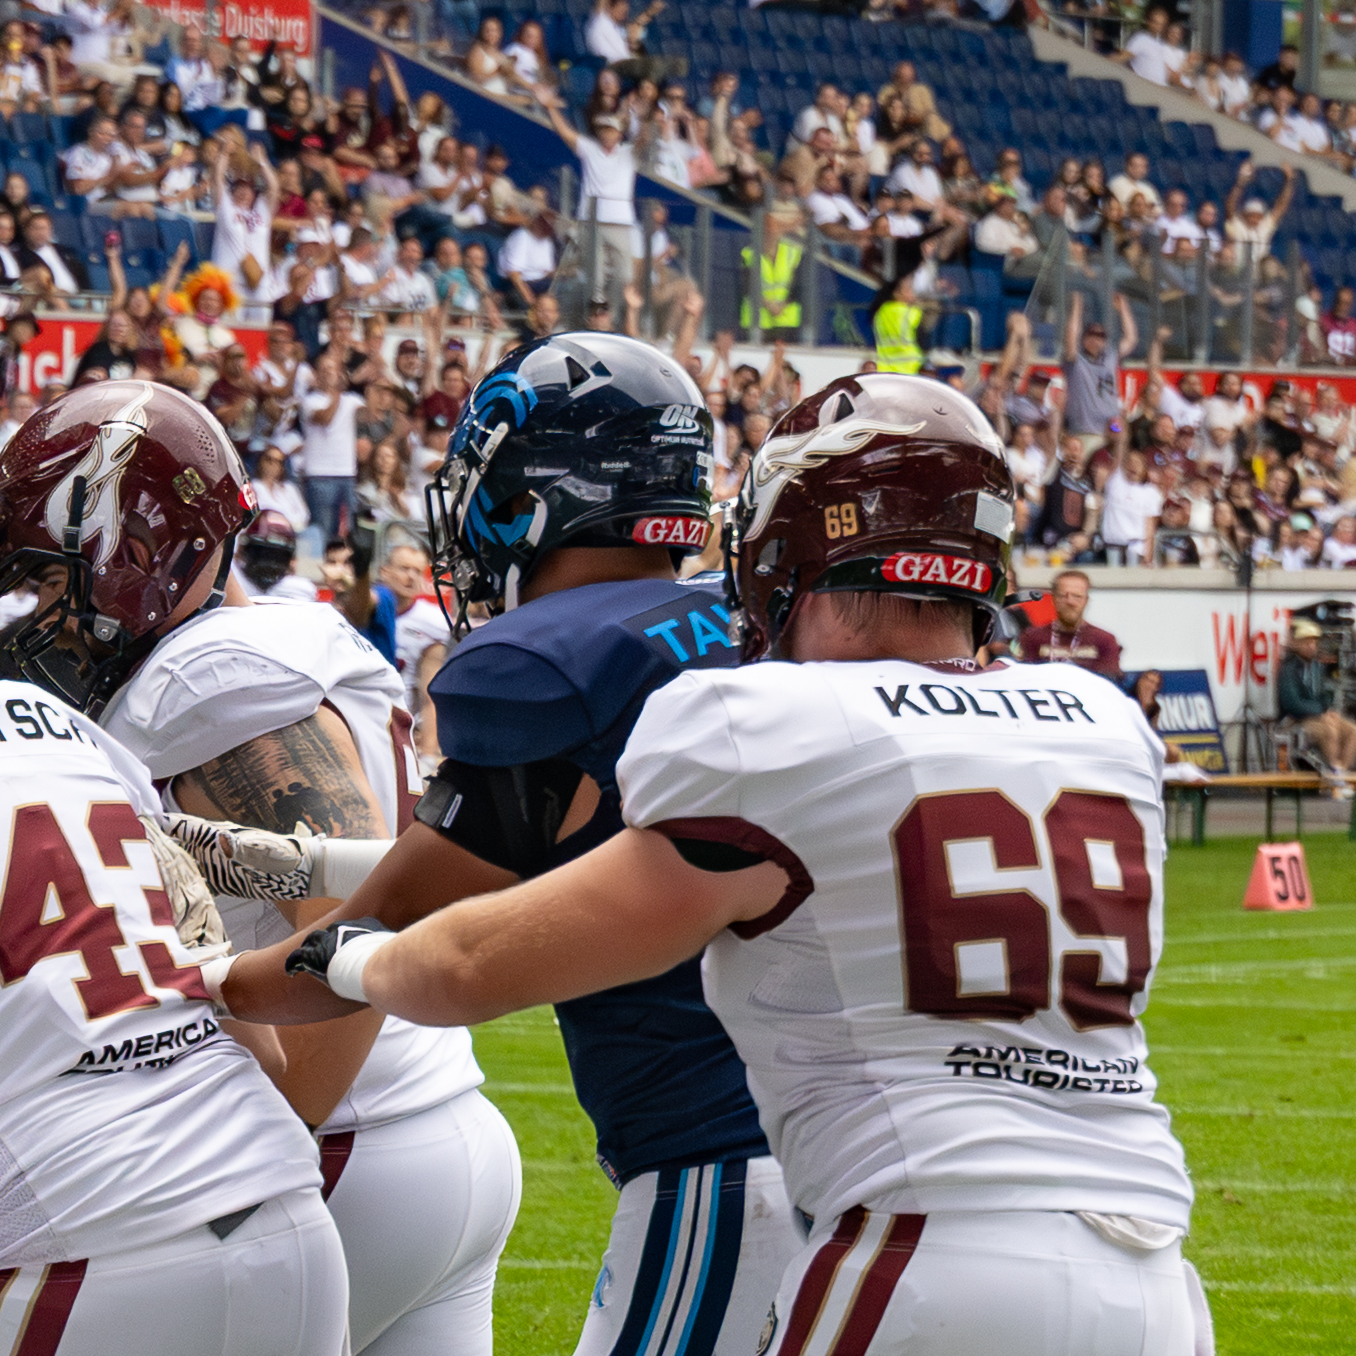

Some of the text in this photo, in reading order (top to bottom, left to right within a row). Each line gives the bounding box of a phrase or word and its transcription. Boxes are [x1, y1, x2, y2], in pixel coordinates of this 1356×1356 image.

[824, 502, 858, 539] 69
[873, 684, 1096, 724] KOLTER
[1270, 856, 1306, 901] 50
[888, 787, 1153, 1026] 69
